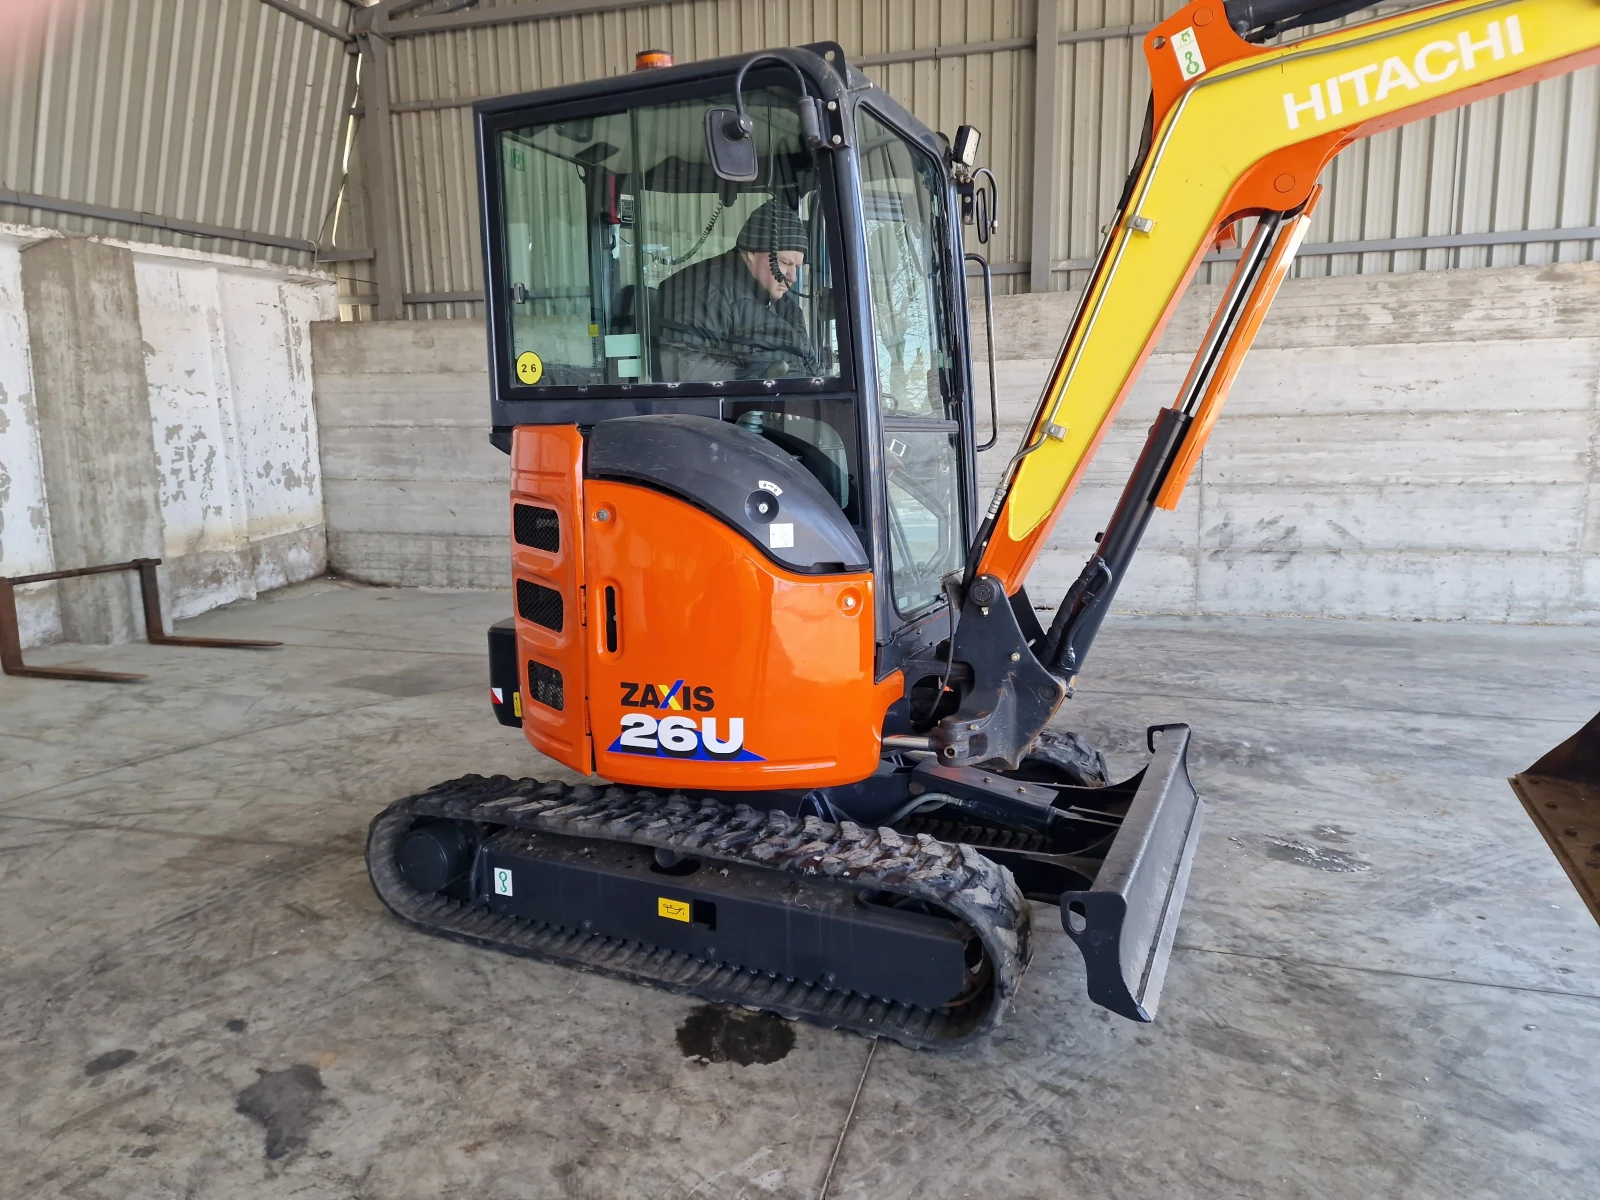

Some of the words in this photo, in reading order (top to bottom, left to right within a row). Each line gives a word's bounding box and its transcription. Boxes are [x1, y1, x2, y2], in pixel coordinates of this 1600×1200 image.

[1283, 15, 1525, 130] HITACHI
[620, 679, 715, 711] ZAXIS
[620, 713, 745, 757] 26U
